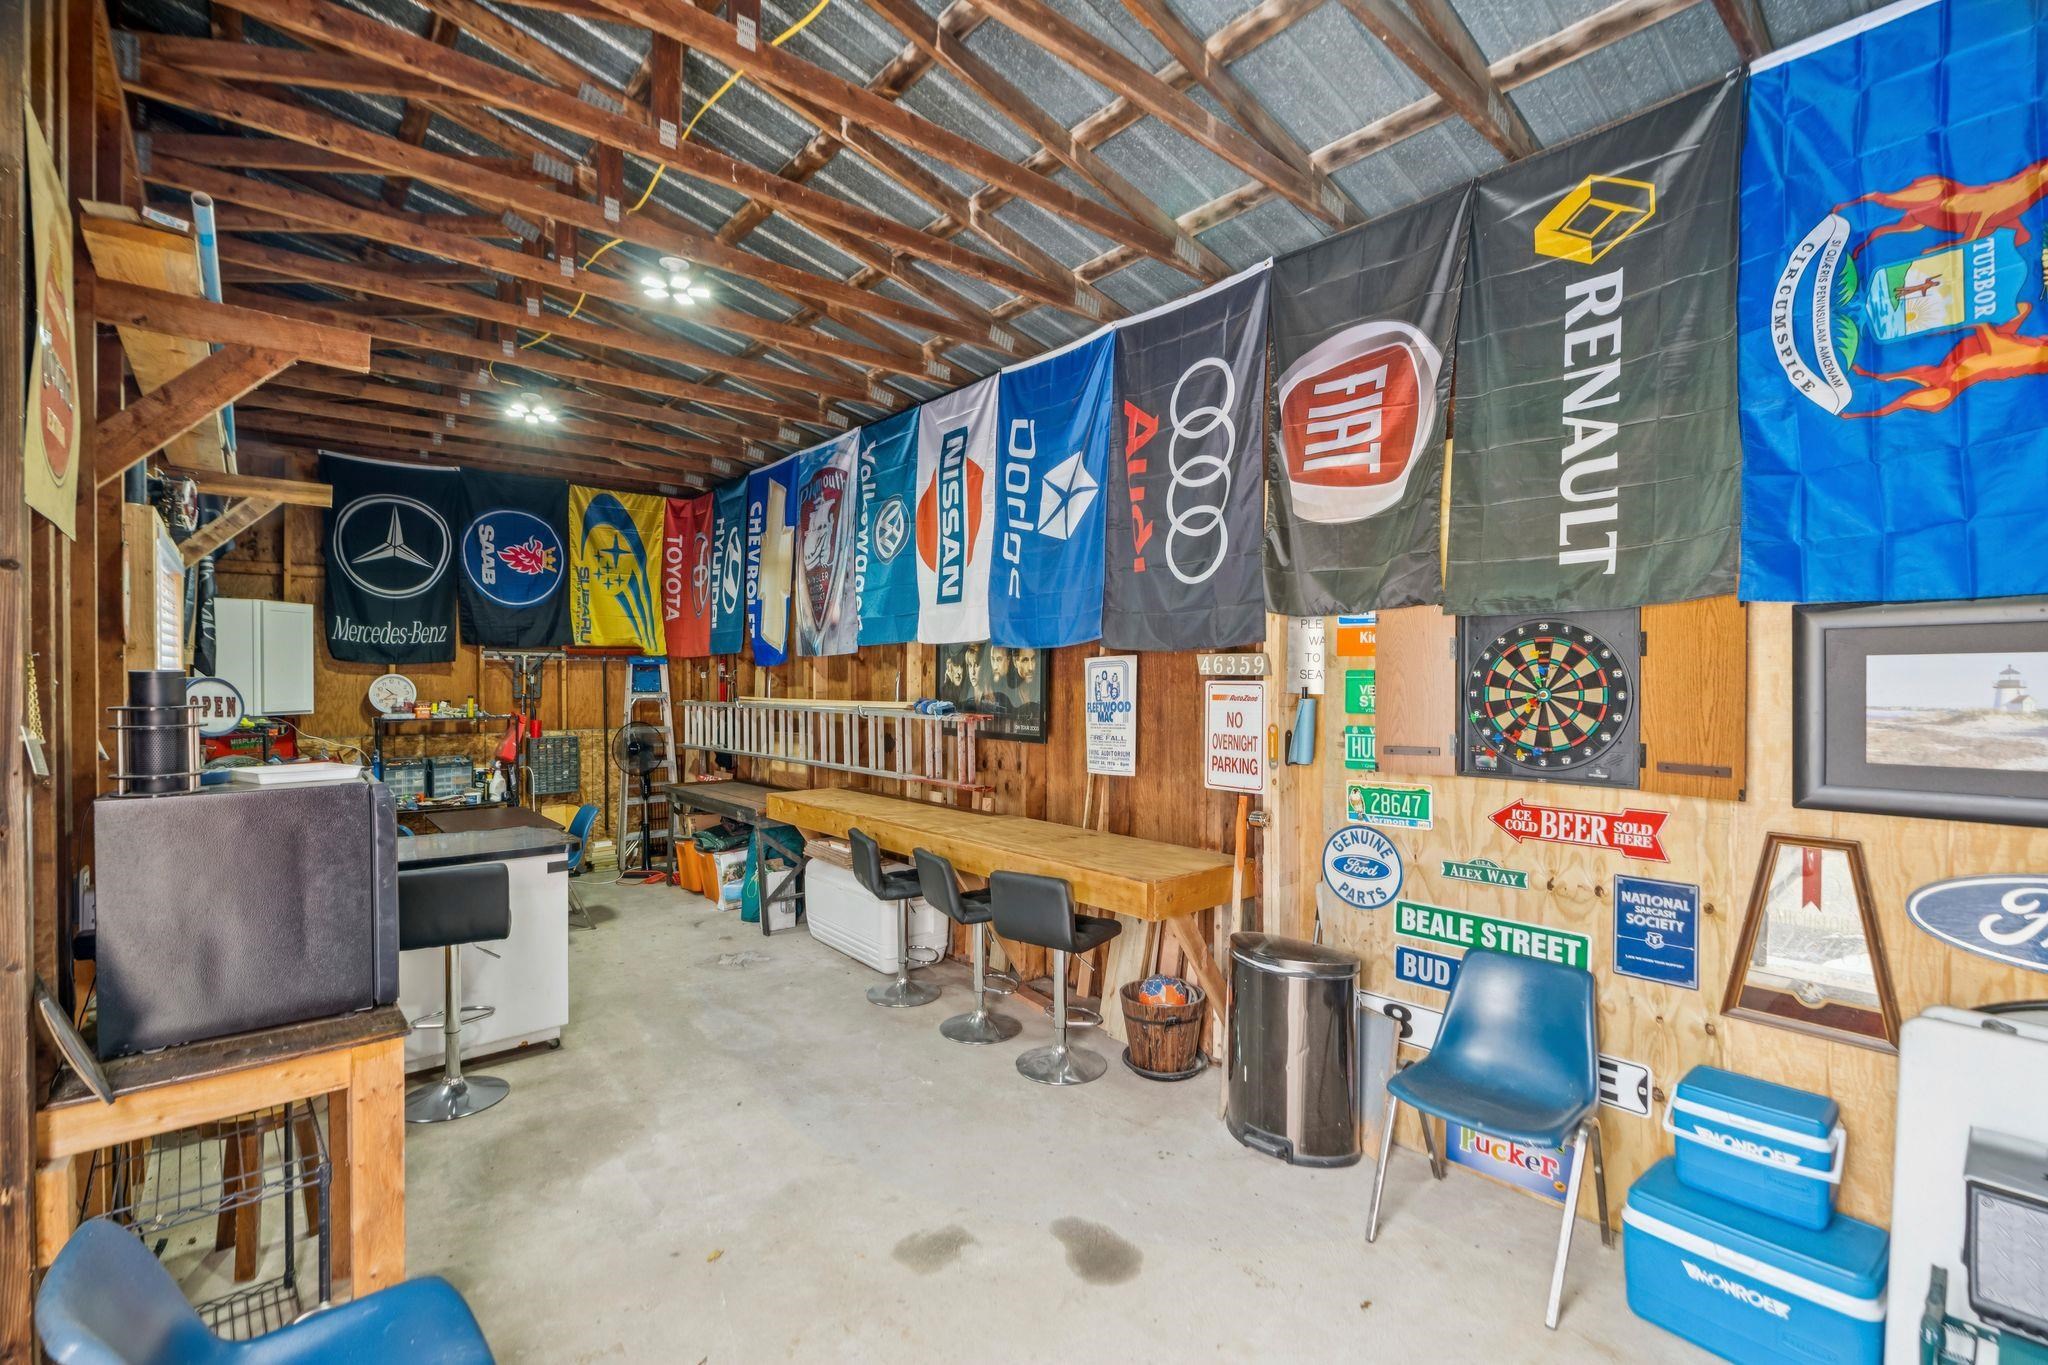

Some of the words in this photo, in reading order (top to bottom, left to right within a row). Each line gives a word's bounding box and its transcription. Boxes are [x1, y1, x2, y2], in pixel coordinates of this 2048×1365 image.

[1972, 238, 1997, 319] TUEBOR
[1774, 242, 1816, 393] CIRCUMSPICE
[1302, 364, 1388, 474] FIAT
[1558, 266, 1624, 575] RENAULT
[940, 435, 964, 598] NISSAN
[478, 524, 496, 585] SAAB
[666, 535, 683, 621] TOYOTA
[332, 615, 448, 645] Mercedes-Benz
[1200, 656, 1265, 675] 46359
[1304, 652, 1320, 662] TO
[1087, 701, 1132, 713] FLEETWOOD
[1229, 694, 1258, 702] AutoZone
[1098, 712, 1114, 723] MAC
[1226, 711, 1244, 728] NO
[1212, 733, 1258, 752] OVERNIGHT
[1212, 755, 1258, 776] PARKING
[1370, 792, 1422, 817] 28647
[1512, 808, 1532, 821] ICE
[1369, 815, 1410, 826] Vermont
[1504, 820, 1538, 832] COLD
[1540, 810, 1610, 846] BEER
[1614, 821, 1653, 836] SOLD
[1332, 830, 1394, 860] GENUINE
[1614, 834, 1653, 848] HERE
[1343, 858, 1379, 876] Ford
[1450, 864, 1482, 880] ALEX
[1486, 868, 1518, 886] WAY
[1338, 882, 1388, 904] PARTS
[1621, 890, 1691, 912] NATIONAL
[1626, 912, 1686, 934] SOCIETY
[1634, 905, 1677, 920] SARCASM
[1402, 906, 1474, 944] BEALE
[1480, 922, 1582, 966] STREET
[1403, 952, 1450, 986] BUD
[1460, 1126, 1560, 1181] Pucker
[1693, 1124, 1802, 1166] MONROE
[1680, 1259, 1792, 1321] MONROE
